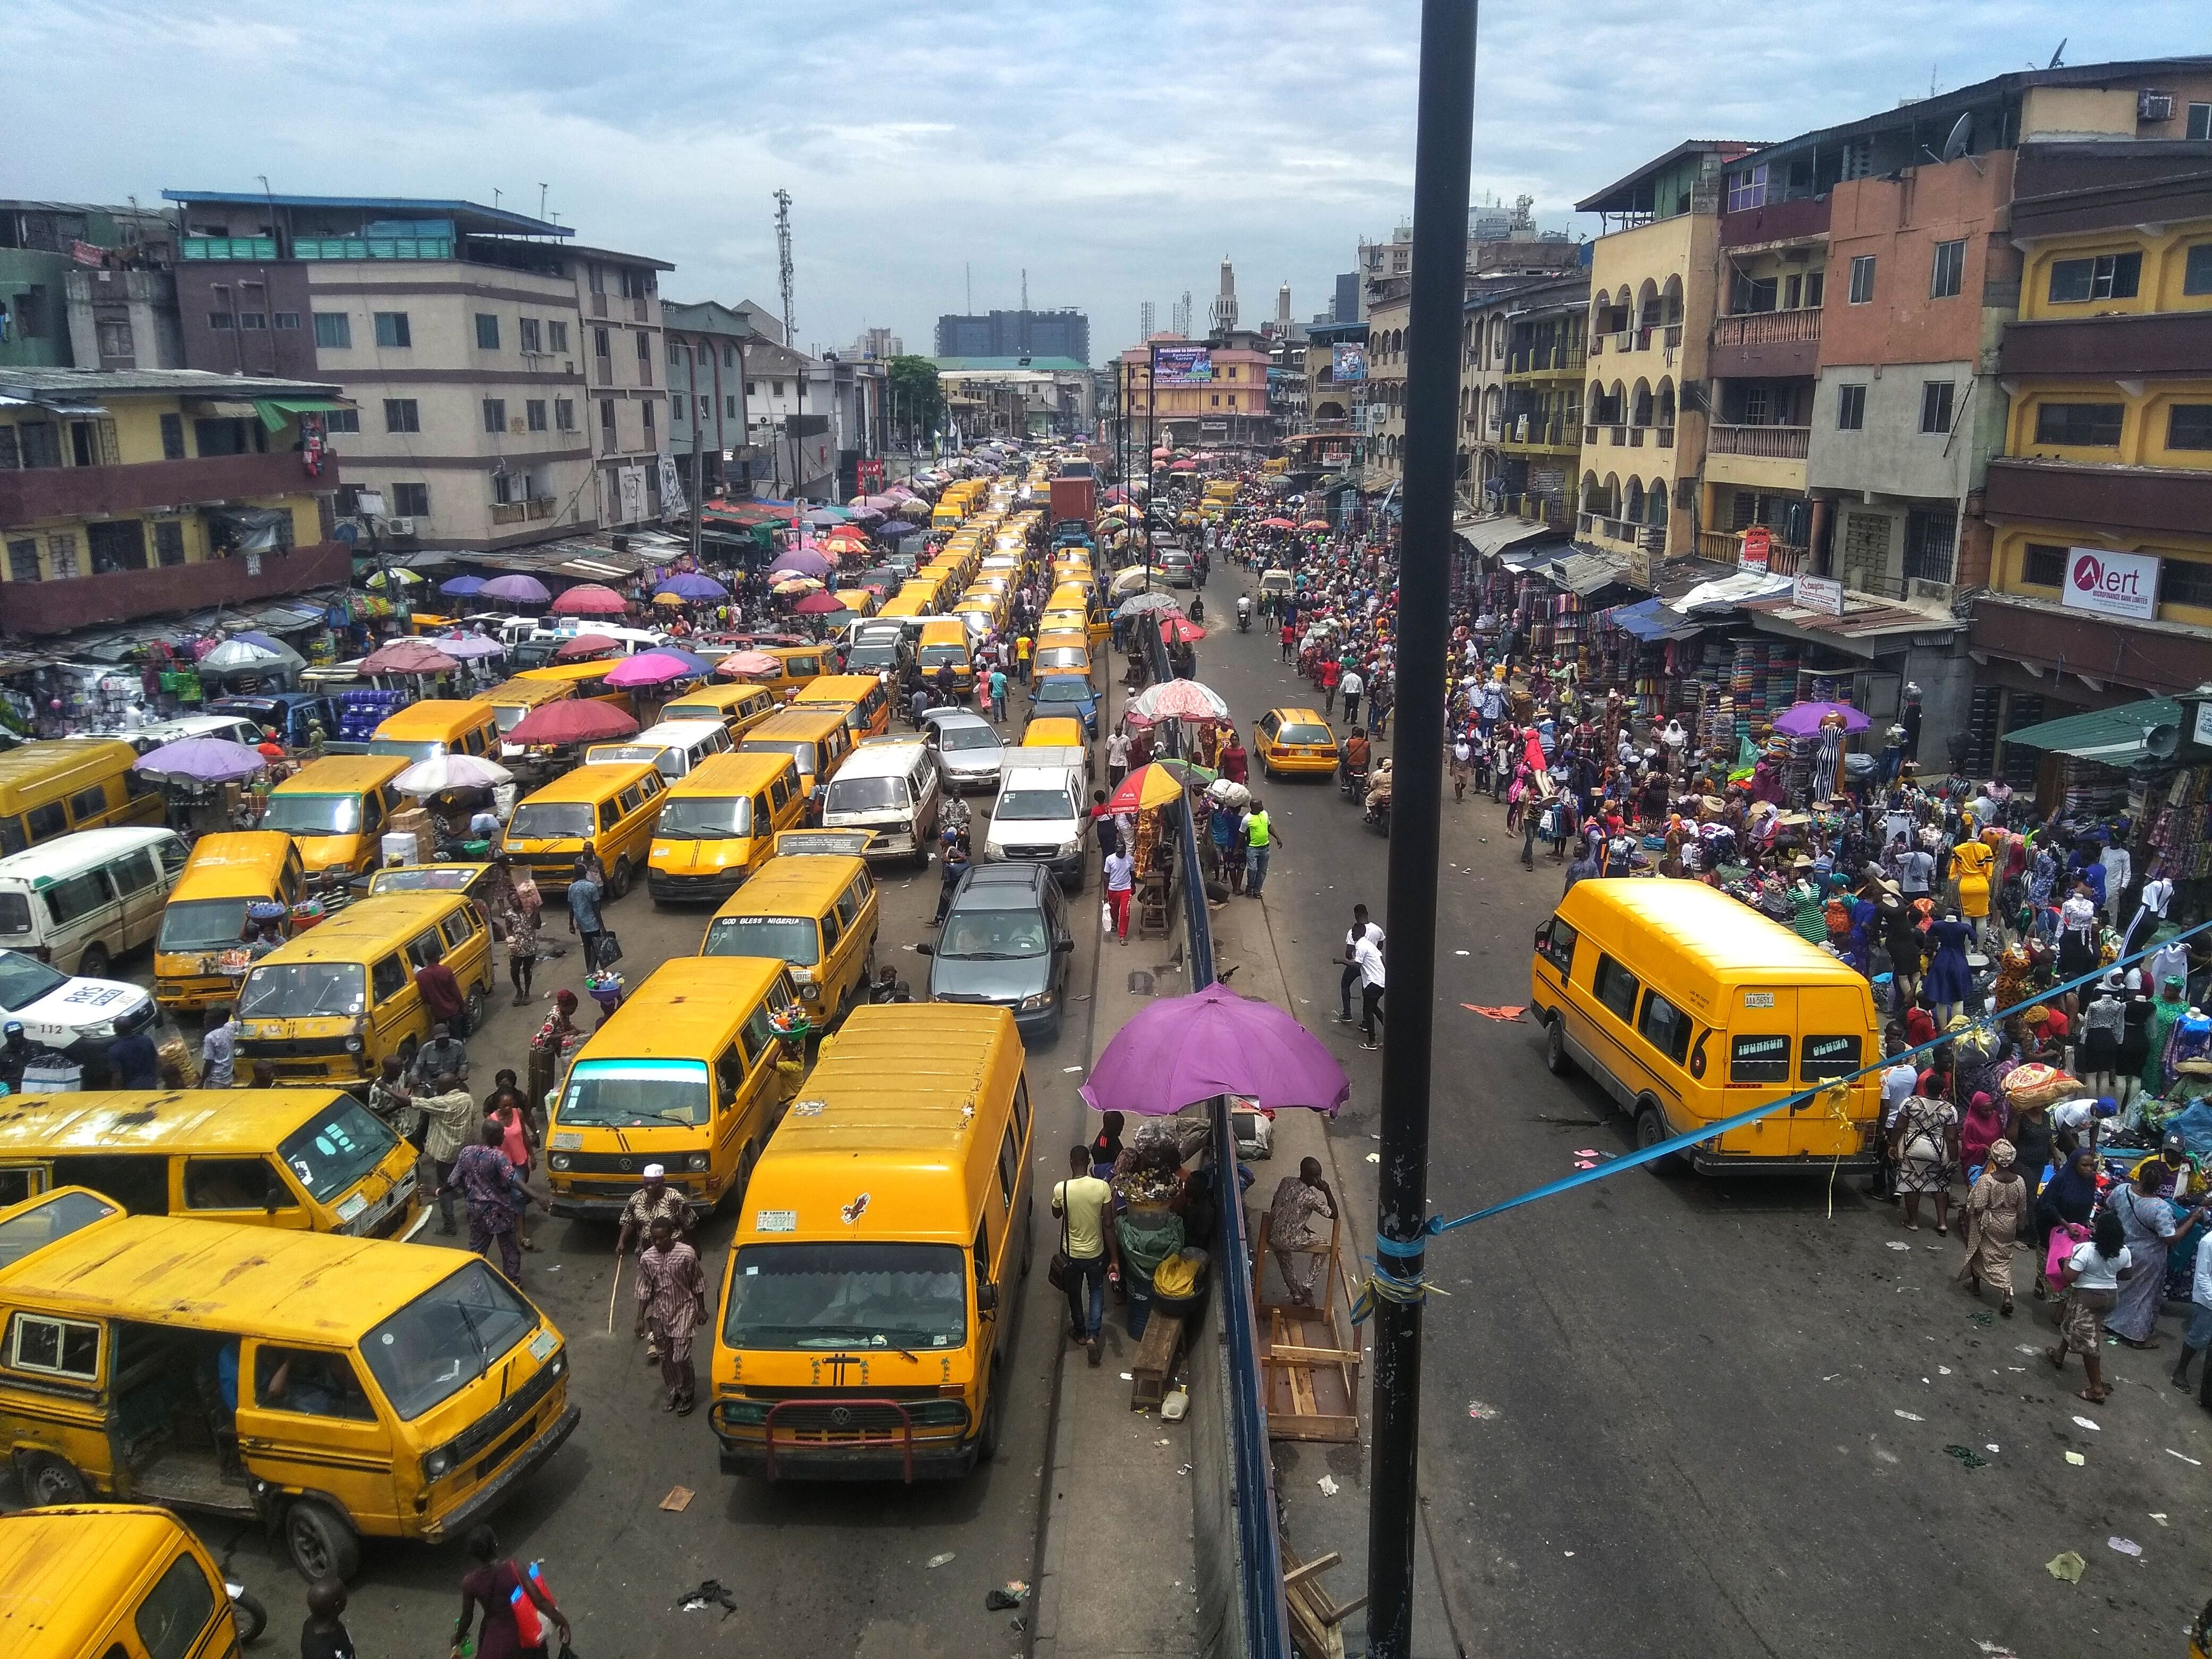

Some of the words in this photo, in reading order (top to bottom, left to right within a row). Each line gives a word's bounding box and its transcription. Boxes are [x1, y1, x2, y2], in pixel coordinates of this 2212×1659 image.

[2074, 556, 2140, 596] Alert
[2092, 590, 2121, 601] MICROFINANCE
[2132, 596, 2148, 605] LIMITED
[63, 986, 104, 1003] RRS
[40, 1024, 63, 1034] 112
[1738, 1038, 1783, 1056] IBUNKUN
[1813, 1038, 1848, 1057] OLUWA
